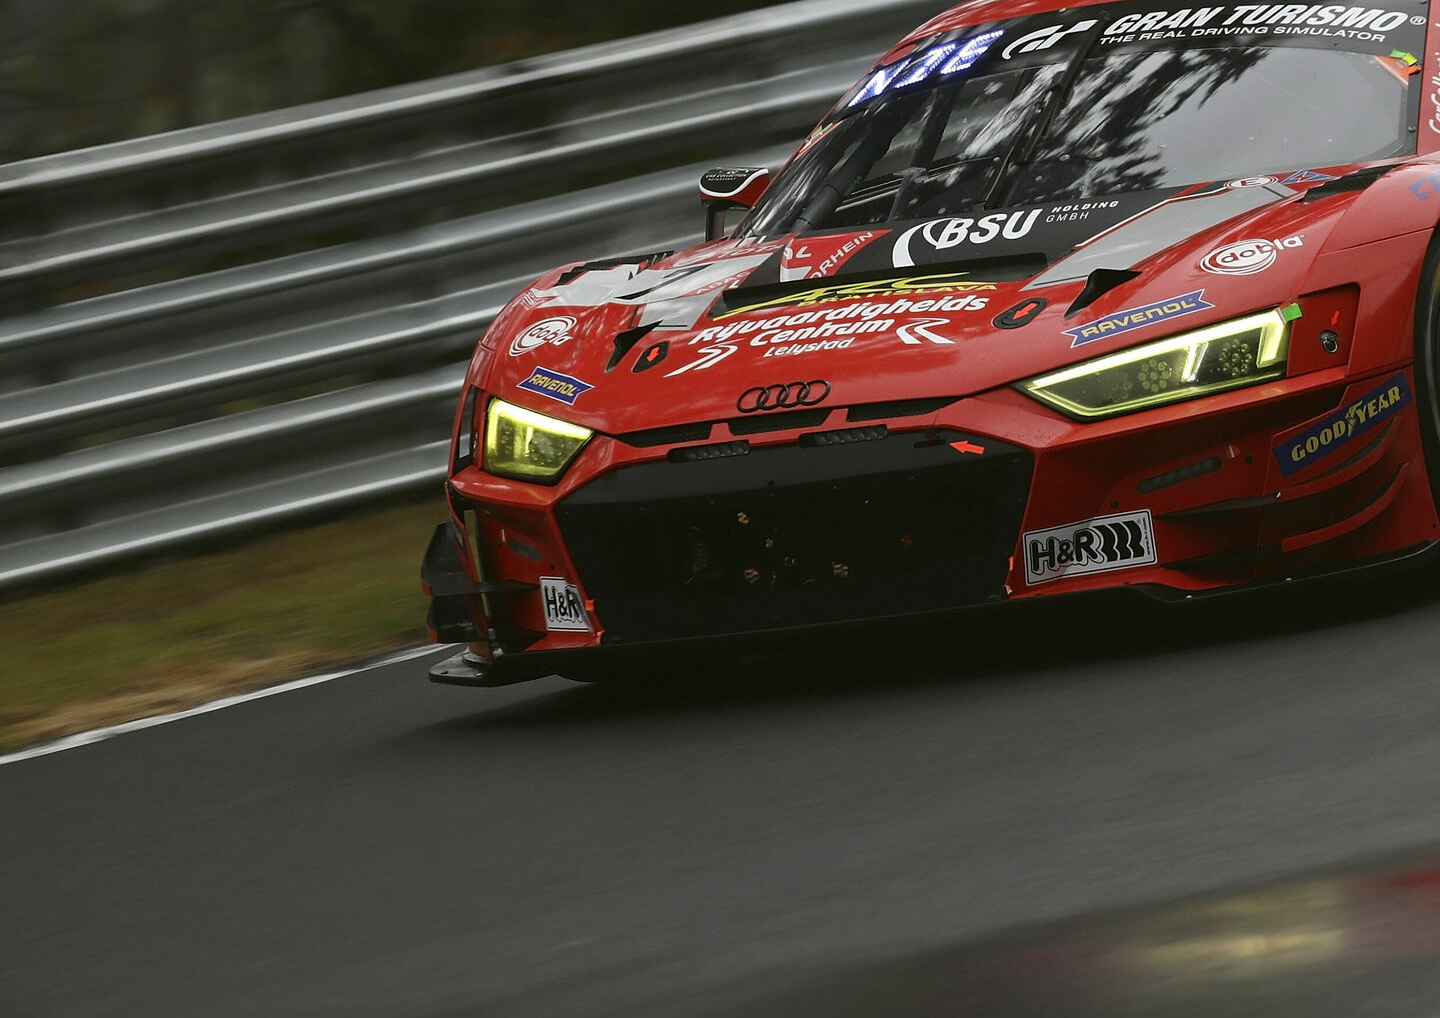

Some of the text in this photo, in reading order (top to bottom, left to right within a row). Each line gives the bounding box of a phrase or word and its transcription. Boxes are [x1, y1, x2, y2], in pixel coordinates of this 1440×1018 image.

[1104, 4, 1408, 35] GRAN TURISMO
[1100, 25, 1386, 45] THE REAL DRIVING SIMULATOR
[1045, 211, 1090, 223] GMBH
[1051, 200, 1120, 213] HOLDING
[934, 208, 1043, 250] BSU
[1220, 234, 1304, 264] dobla
[750, 318, 895, 346] Centrum
[1080, 299, 1196, 338] RAVENOL
[763, 337, 856, 358] Lelystad
[528, 373, 578, 398] RAVENOL
[1291, 385, 1401, 462] GOODYEAR
[1029, 527, 1105, 575] H&R
[544, 585, 583, 623] H&R
